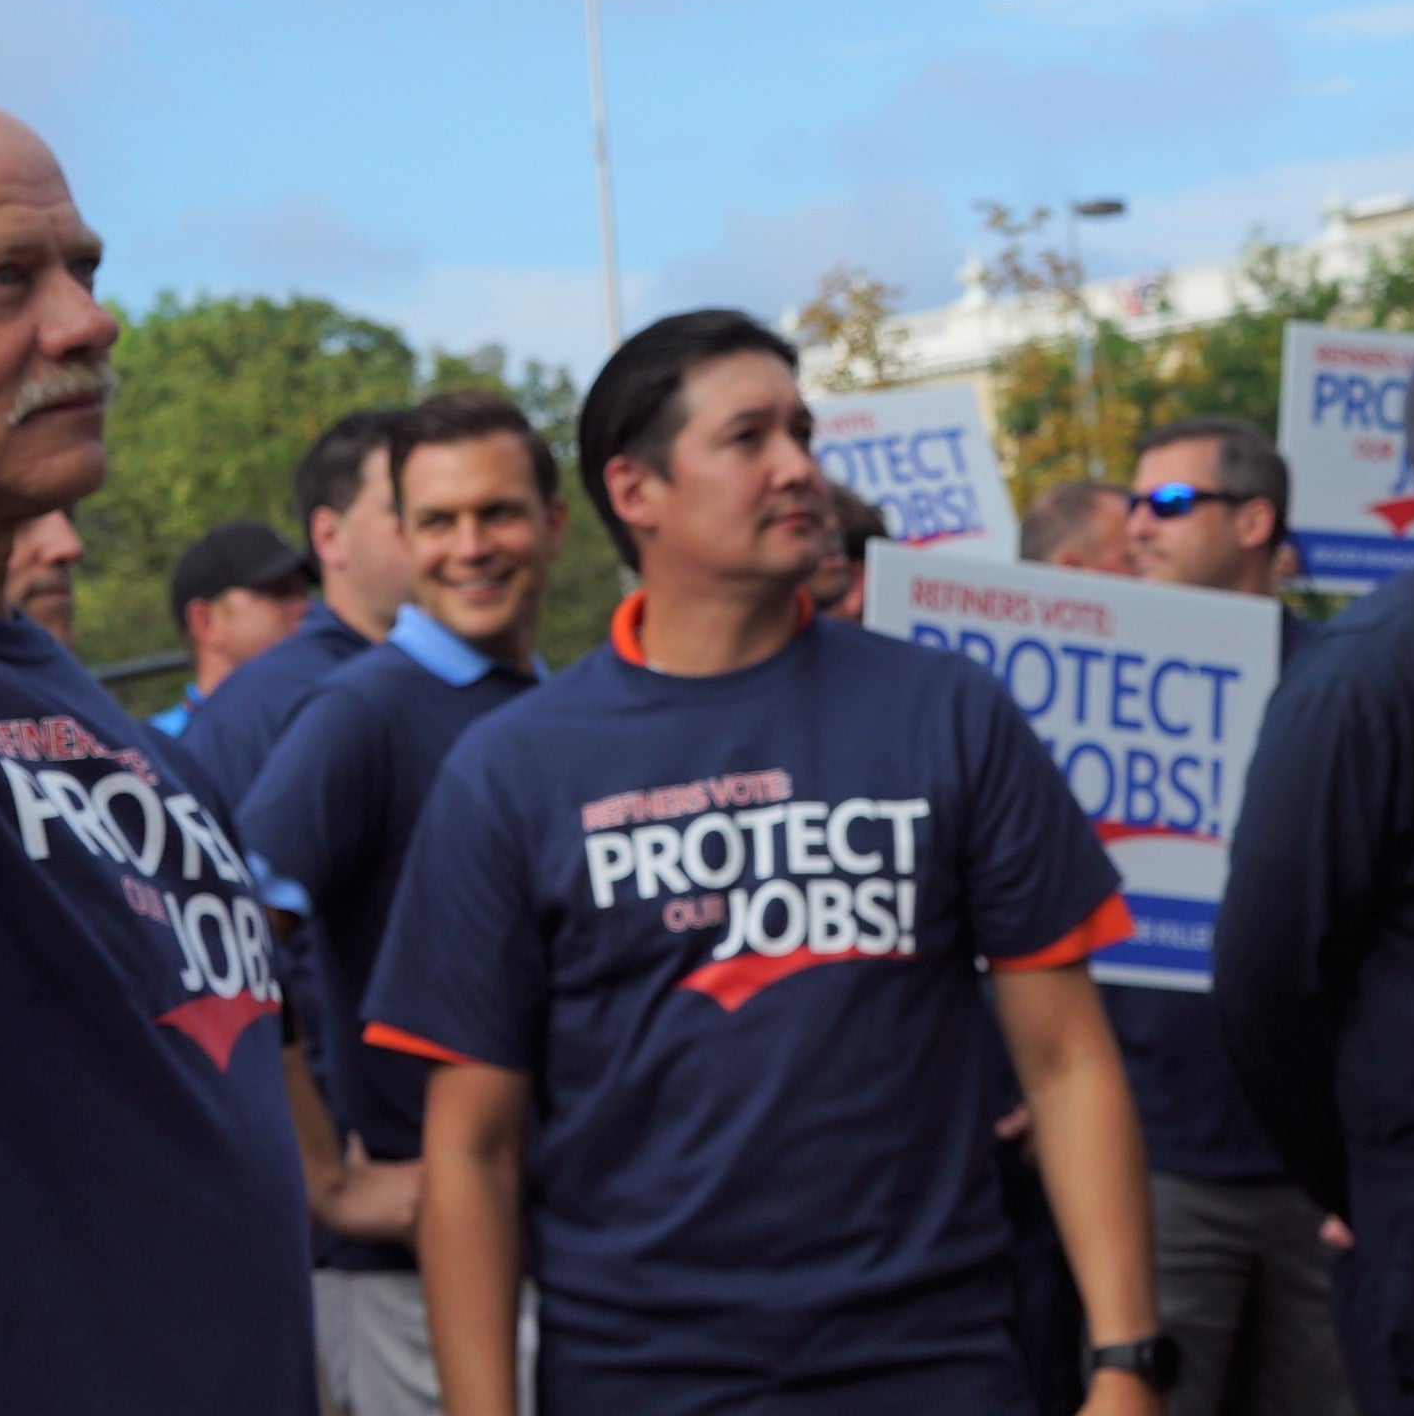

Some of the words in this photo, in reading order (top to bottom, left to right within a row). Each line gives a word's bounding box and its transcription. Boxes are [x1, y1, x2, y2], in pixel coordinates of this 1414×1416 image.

[584, 796, 932, 910] PROTECT
[661, 892, 729, 934] OUR
[712, 876, 918, 962] JOBS!
